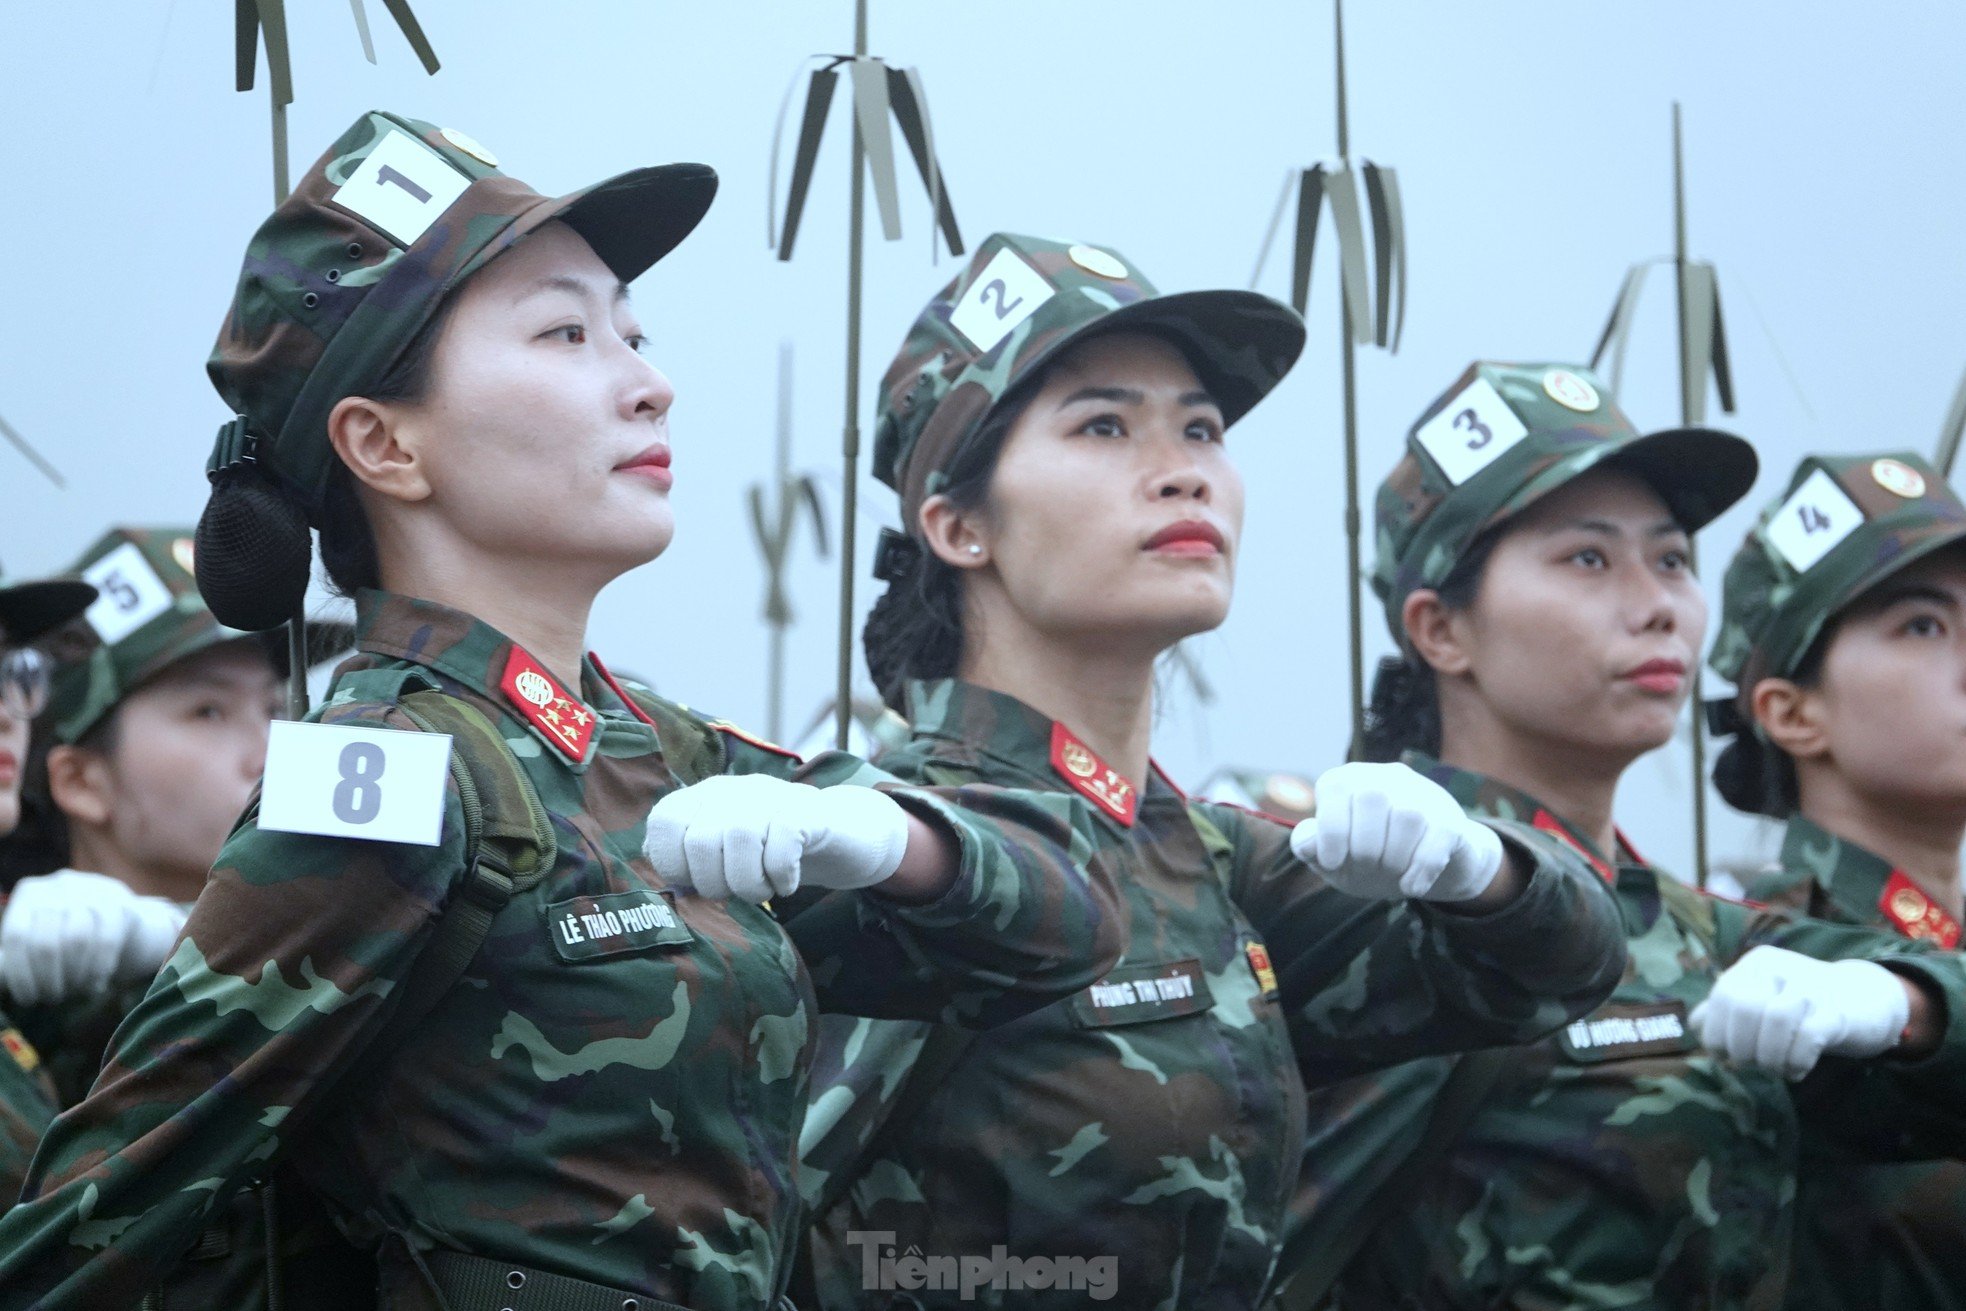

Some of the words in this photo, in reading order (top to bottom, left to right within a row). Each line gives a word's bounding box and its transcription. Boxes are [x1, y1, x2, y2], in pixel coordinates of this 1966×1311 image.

[375, 164, 433, 205] 1
[979, 278, 1024, 322] 2
[1452, 407, 1493, 451] 3
[1798, 504, 1832, 537] 4
[103, 569, 140, 610] 5
[332, 741, 386, 824] 8
[559, 913, 585, 945] LÊ
[581, 903, 622, 940] THẢO
[618, 902, 677, 933] PHƯƠNG
